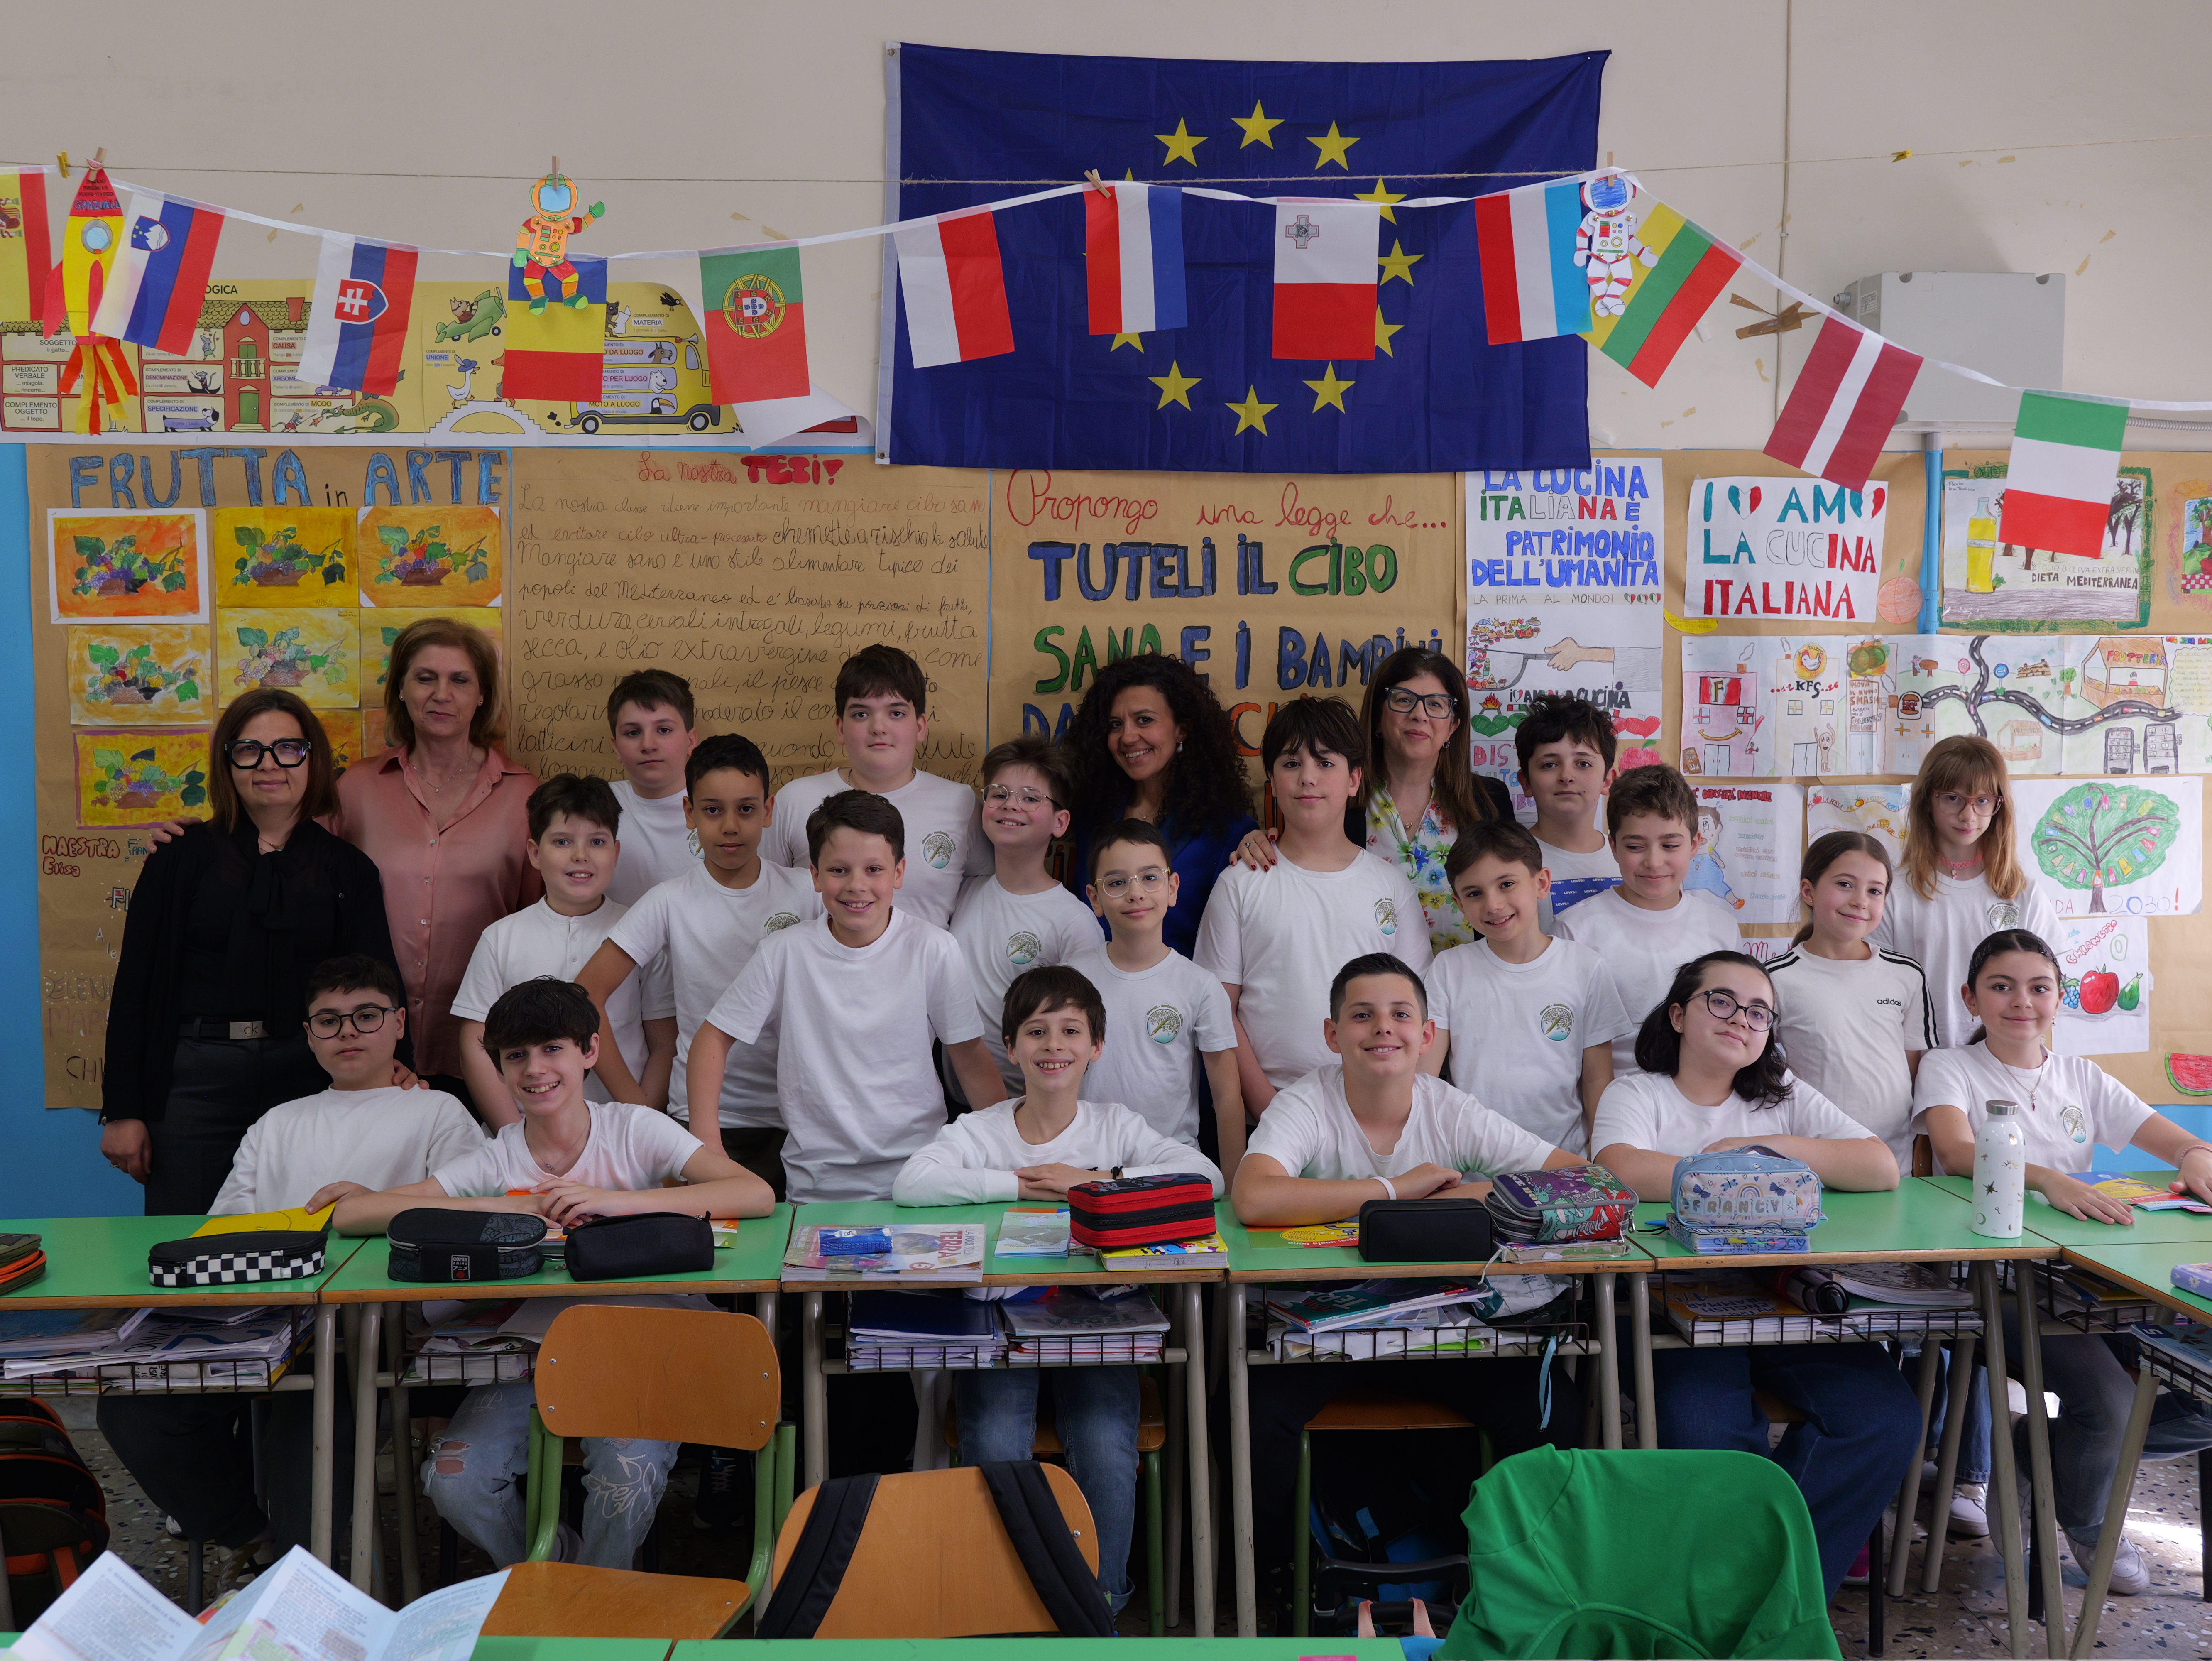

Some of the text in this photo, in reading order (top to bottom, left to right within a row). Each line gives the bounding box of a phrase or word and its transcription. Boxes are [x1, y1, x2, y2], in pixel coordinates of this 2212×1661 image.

[70, 448, 502, 509] FRUTTA in ARTE
[638, 450, 671, 482] La
[677, 458, 737, 485] nostra
[1484, 470, 1522, 491] LA
[518, 483, 545, 512] La
[555, 497, 608, 513] nostra
[614, 497, 647, 513] classe
[706, 493, 790, 517] importante
[798, 498, 900, 528] mangiare
[906, 492, 947, 512] cibo
[1007, 469, 1158, 535] Propongo
[1196, 503, 1264, 526] una
[1275, 481, 1352, 539] legge
[521, 524, 539, 540] ed
[553, 527, 608, 541] evitare
[618, 526, 655, 541] cibo
[517, 540, 617, 576] Mangiare
[627, 554, 665, 568] sano
[691, 554, 720, 569] uno
[727, 547, 763, 568] stile
[772, 547, 866, 572] alimentare
[930, 554, 958, 574] dei
[1703, 529, 1877, 574] LA CUCINA
[2031, 572, 2139, 590] DIETA MEDITERRANEA
[2042, 563, 2060, 572] OLIO
[2062, 563, 2091, 573] D'OLIVA
[2092, 564, 2115, 575] EXTRA
[518, 580, 575, 601] popoli
[585, 582, 608, 599] del
[740, 585, 760, 605] ed
[1473, 594, 1614, 605] LA PRIMA AL MONDO!
[1703, 579, 1856, 620] ITALIANA
[905, 615, 978, 640] frutta
[594, 642, 608, 659] e
[616, 634, 663, 660] olio
[925, 648, 983, 668] come
[522, 671, 603, 702] grasso
[1850, 696, 1879, 706] SMASH
[518, 695, 803, 736] regolar il
[42, 835, 120, 859] MAESTRA
[43, 856, 80, 877] Elisa
[1877, 997, 1902, 1007] adidas
[1693, 1198, 1780, 1213] FRANCY
[1686, 1296, 1772, 1308] GRAMMAR
[1702, 1303, 1770, 1313] ENGLISH
